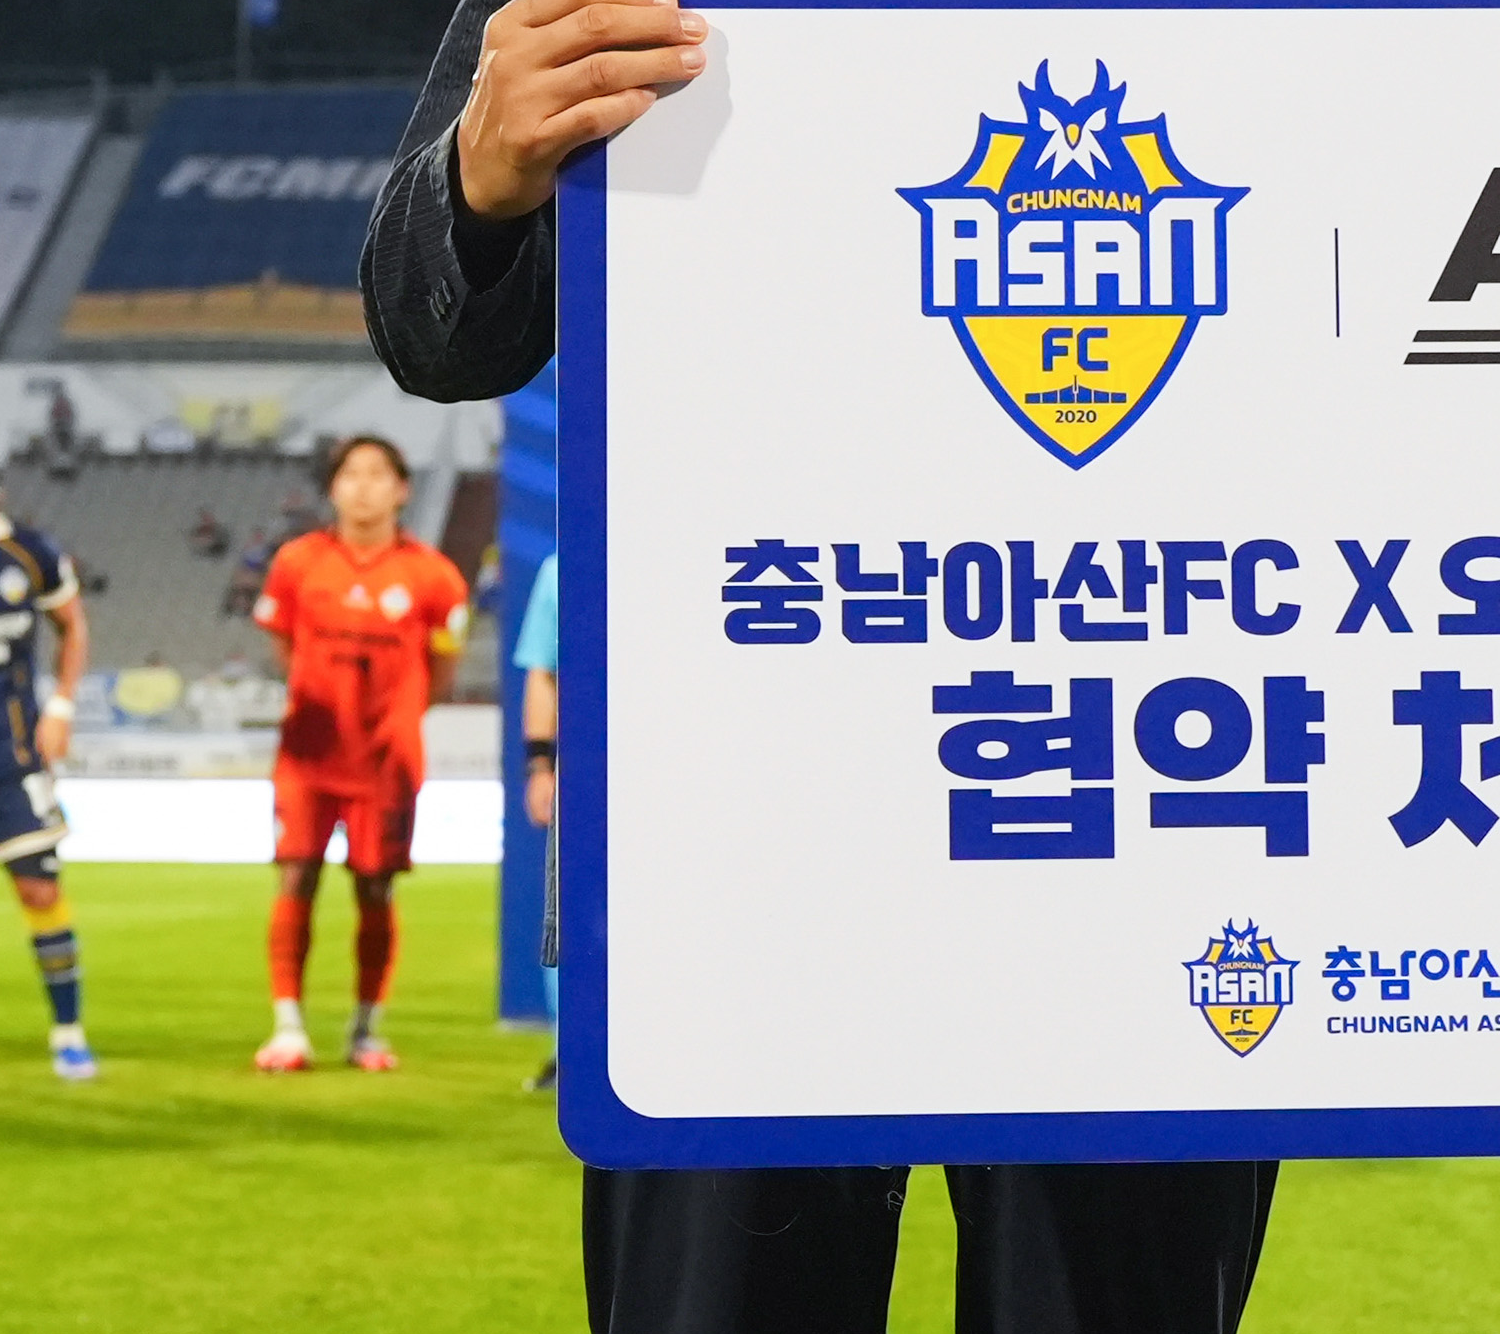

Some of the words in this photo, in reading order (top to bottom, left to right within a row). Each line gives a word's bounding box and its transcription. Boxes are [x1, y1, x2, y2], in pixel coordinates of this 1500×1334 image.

[1006, 188, 1143, 215] CHUNGNAM
[922, 197, 1225, 307] ASAN
[1041, 327, 1109, 372] FC
[1055, 409, 1098, 424] 2020
[722, 539, 1301, 644] 충남아산FC
[1336, 540, 1413, 633] X
[932, 671, 1325, 860] 협약
[1190, 964, 1292, 1003] ASAN
[1230, 1009, 1253, 1025] FC
[1328, 1015, 1469, 1034] CHUNGNAM
